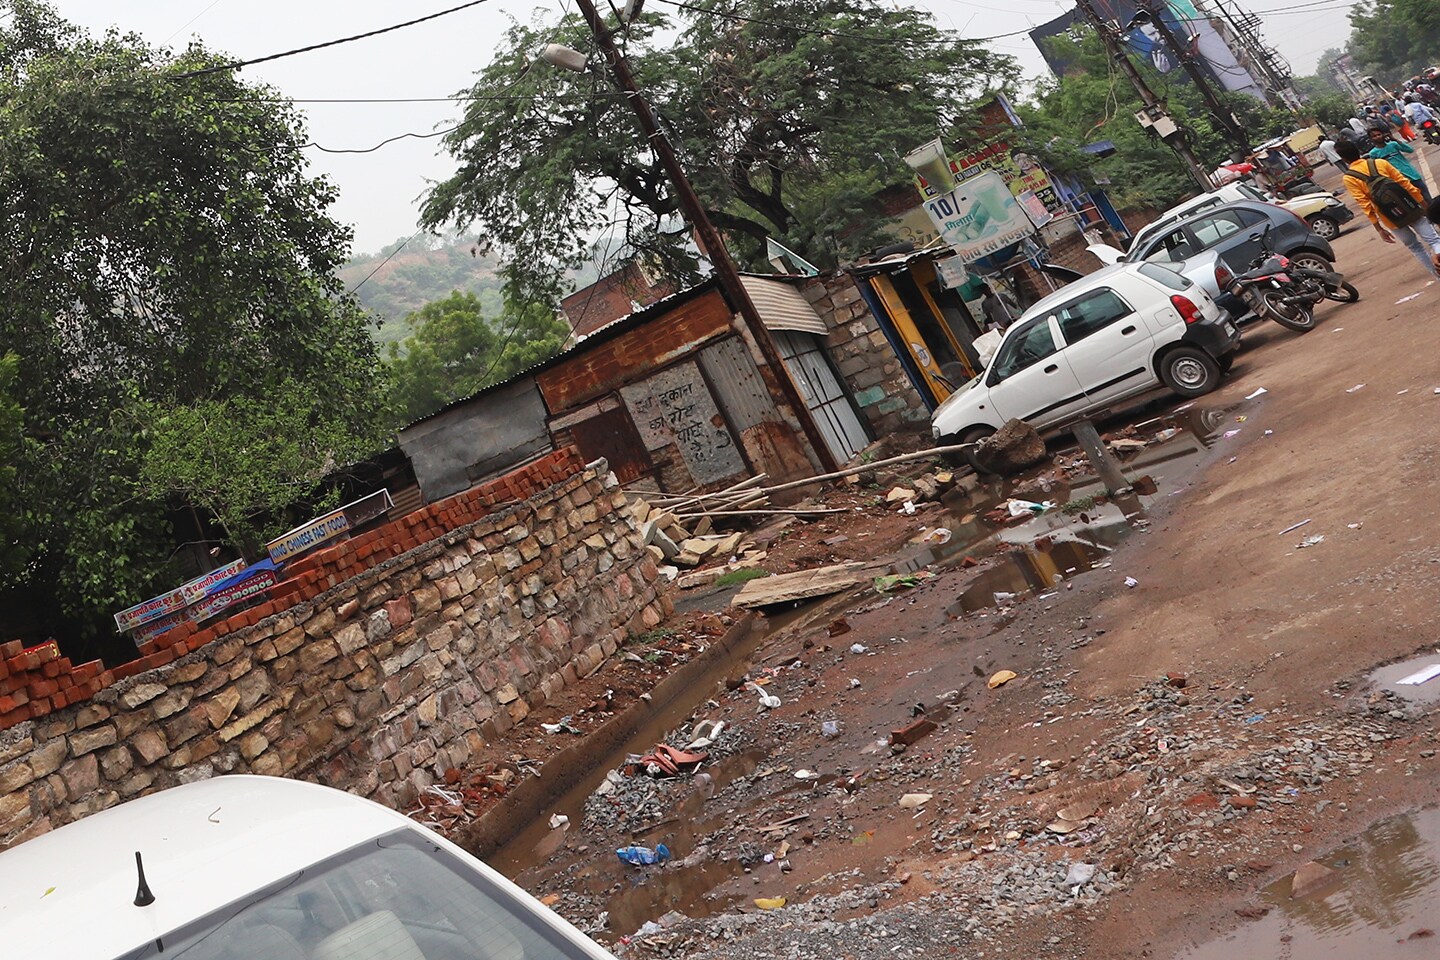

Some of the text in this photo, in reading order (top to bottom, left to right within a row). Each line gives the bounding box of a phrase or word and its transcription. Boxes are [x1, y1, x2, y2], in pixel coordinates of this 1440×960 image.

[929, 191, 967, 220] 10/-
[658, 383, 693, 410] दुकान
[270, 515, 347, 559] KING CHINESE FAST FOOD
[211, 586, 236, 599] THAI
[239, 573, 269, 589] FOOD
[231, 579, 274, 601] momos
